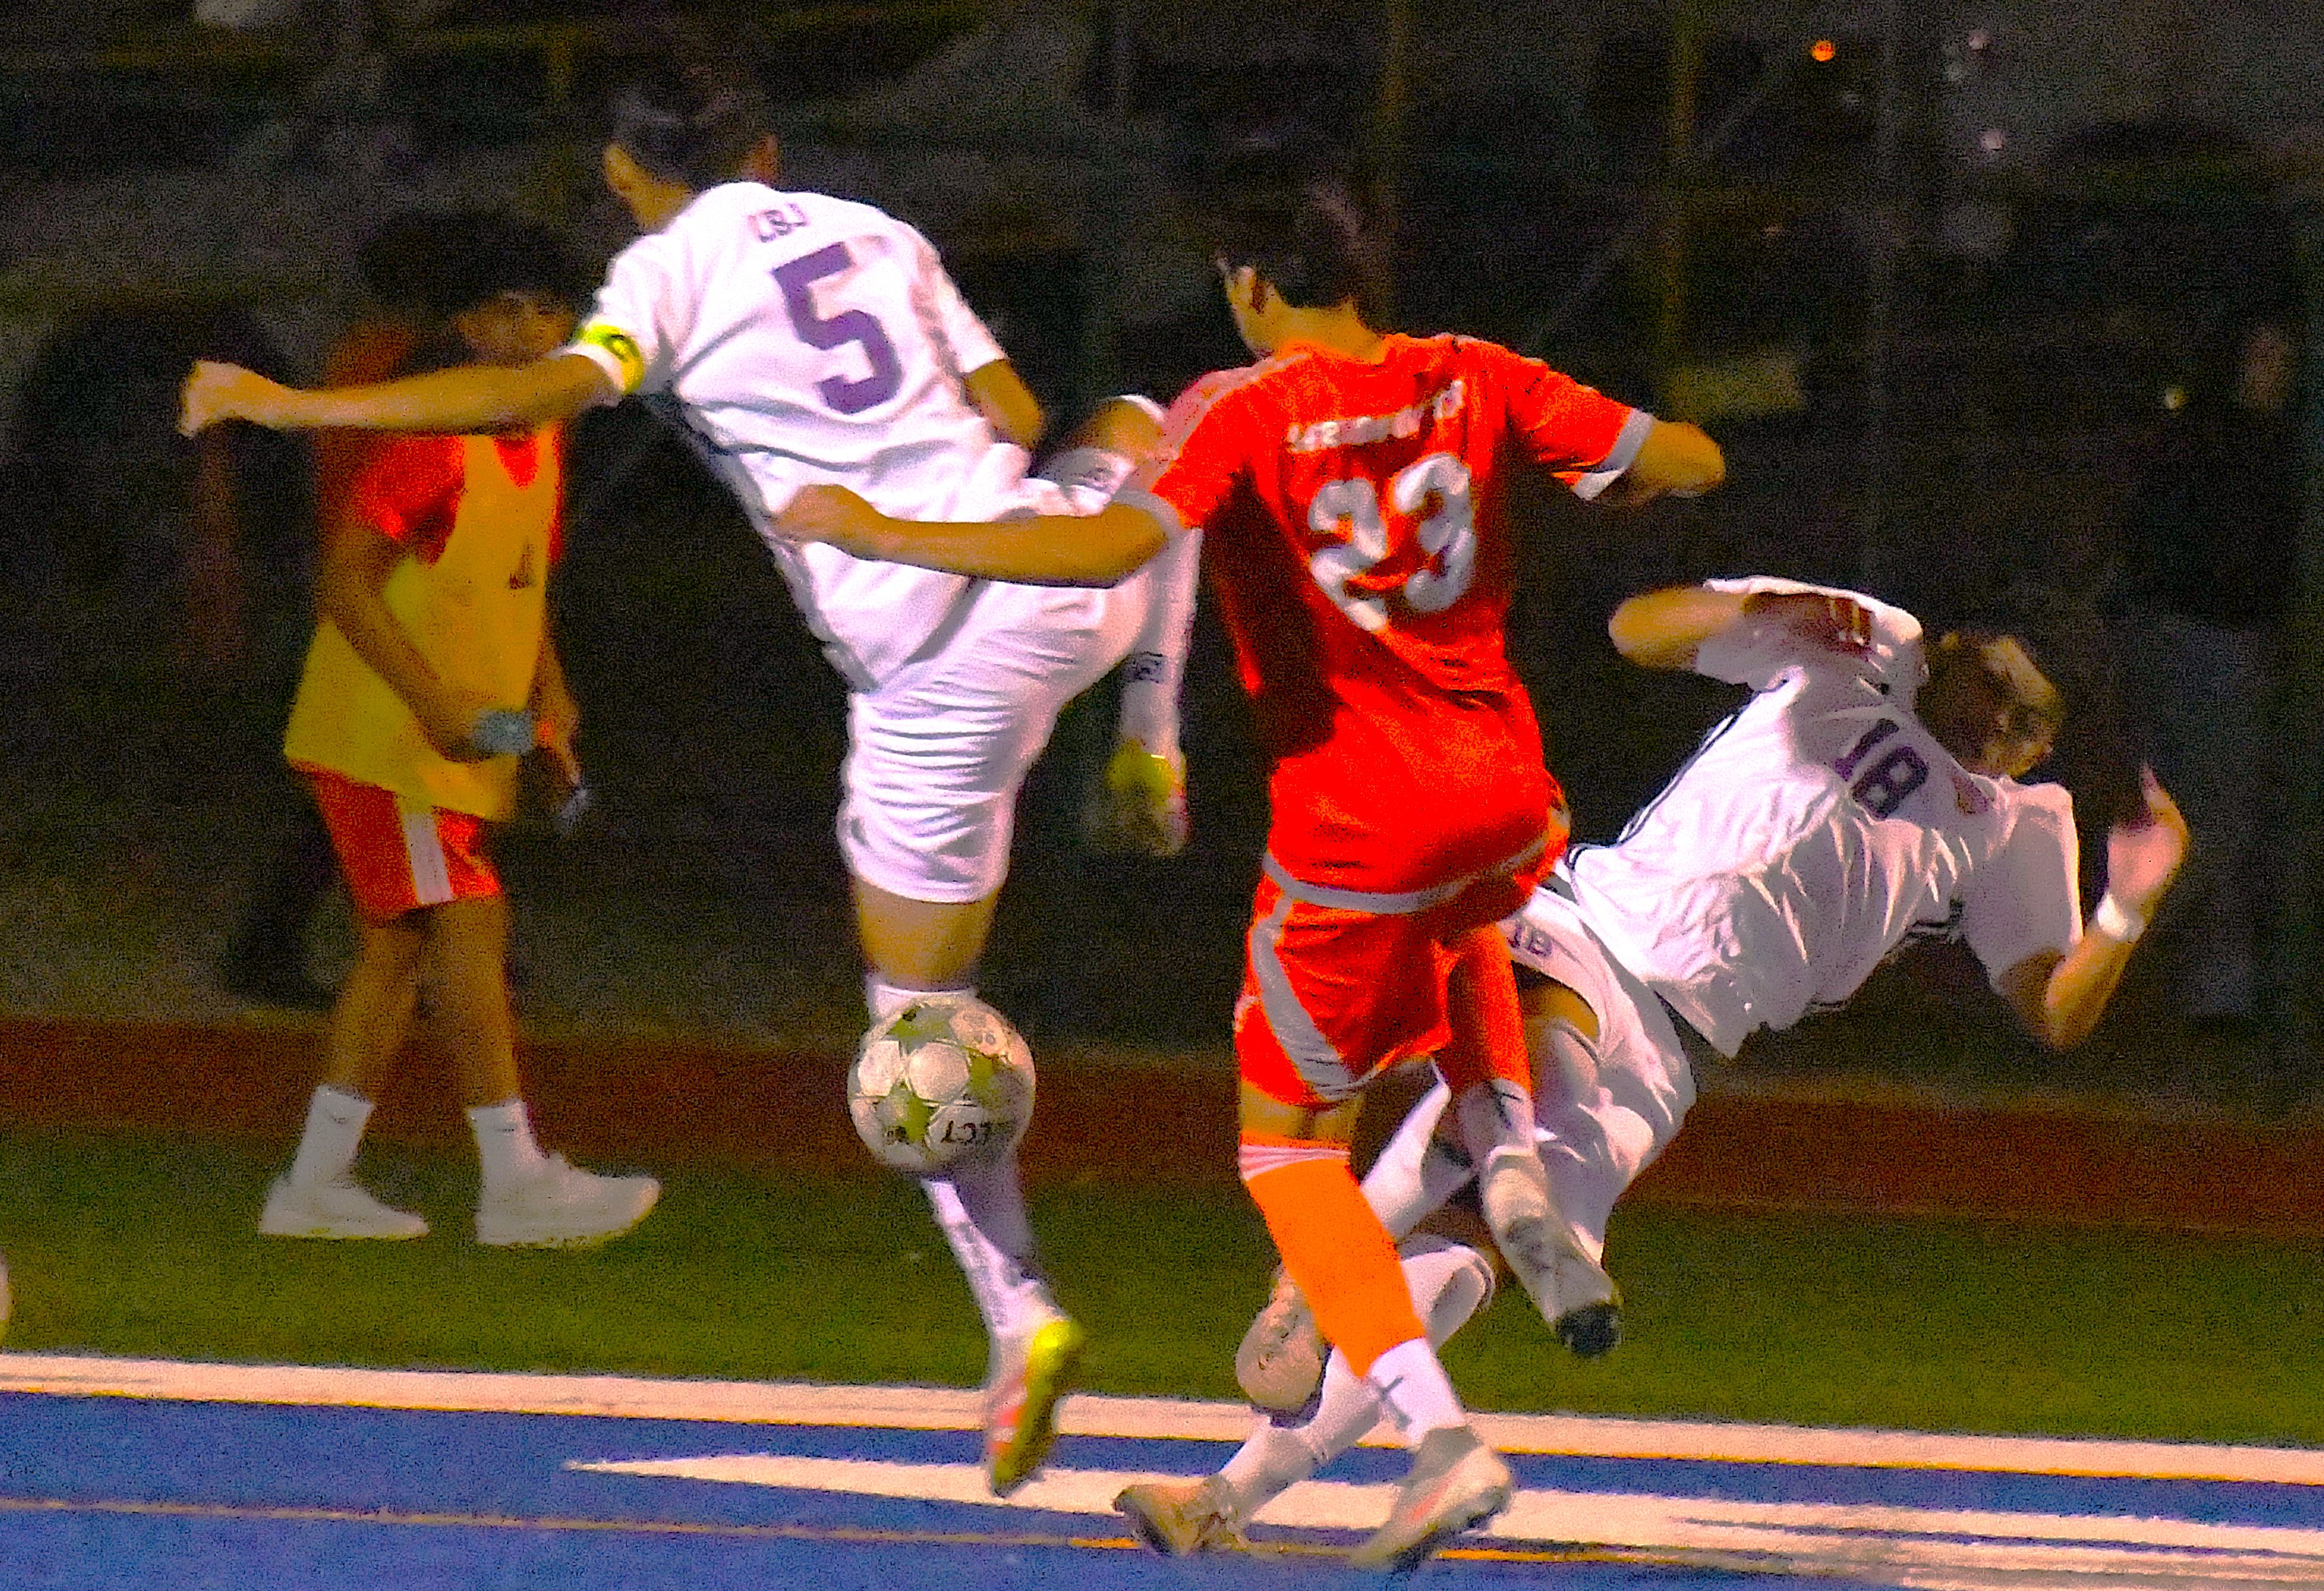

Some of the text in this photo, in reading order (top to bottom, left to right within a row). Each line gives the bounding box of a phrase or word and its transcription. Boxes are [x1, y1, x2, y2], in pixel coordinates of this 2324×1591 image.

[769, 239, 903, 414] 5
[1307, 451, 1477, 632] 23
[1835, 718, 1929, 821] 18
